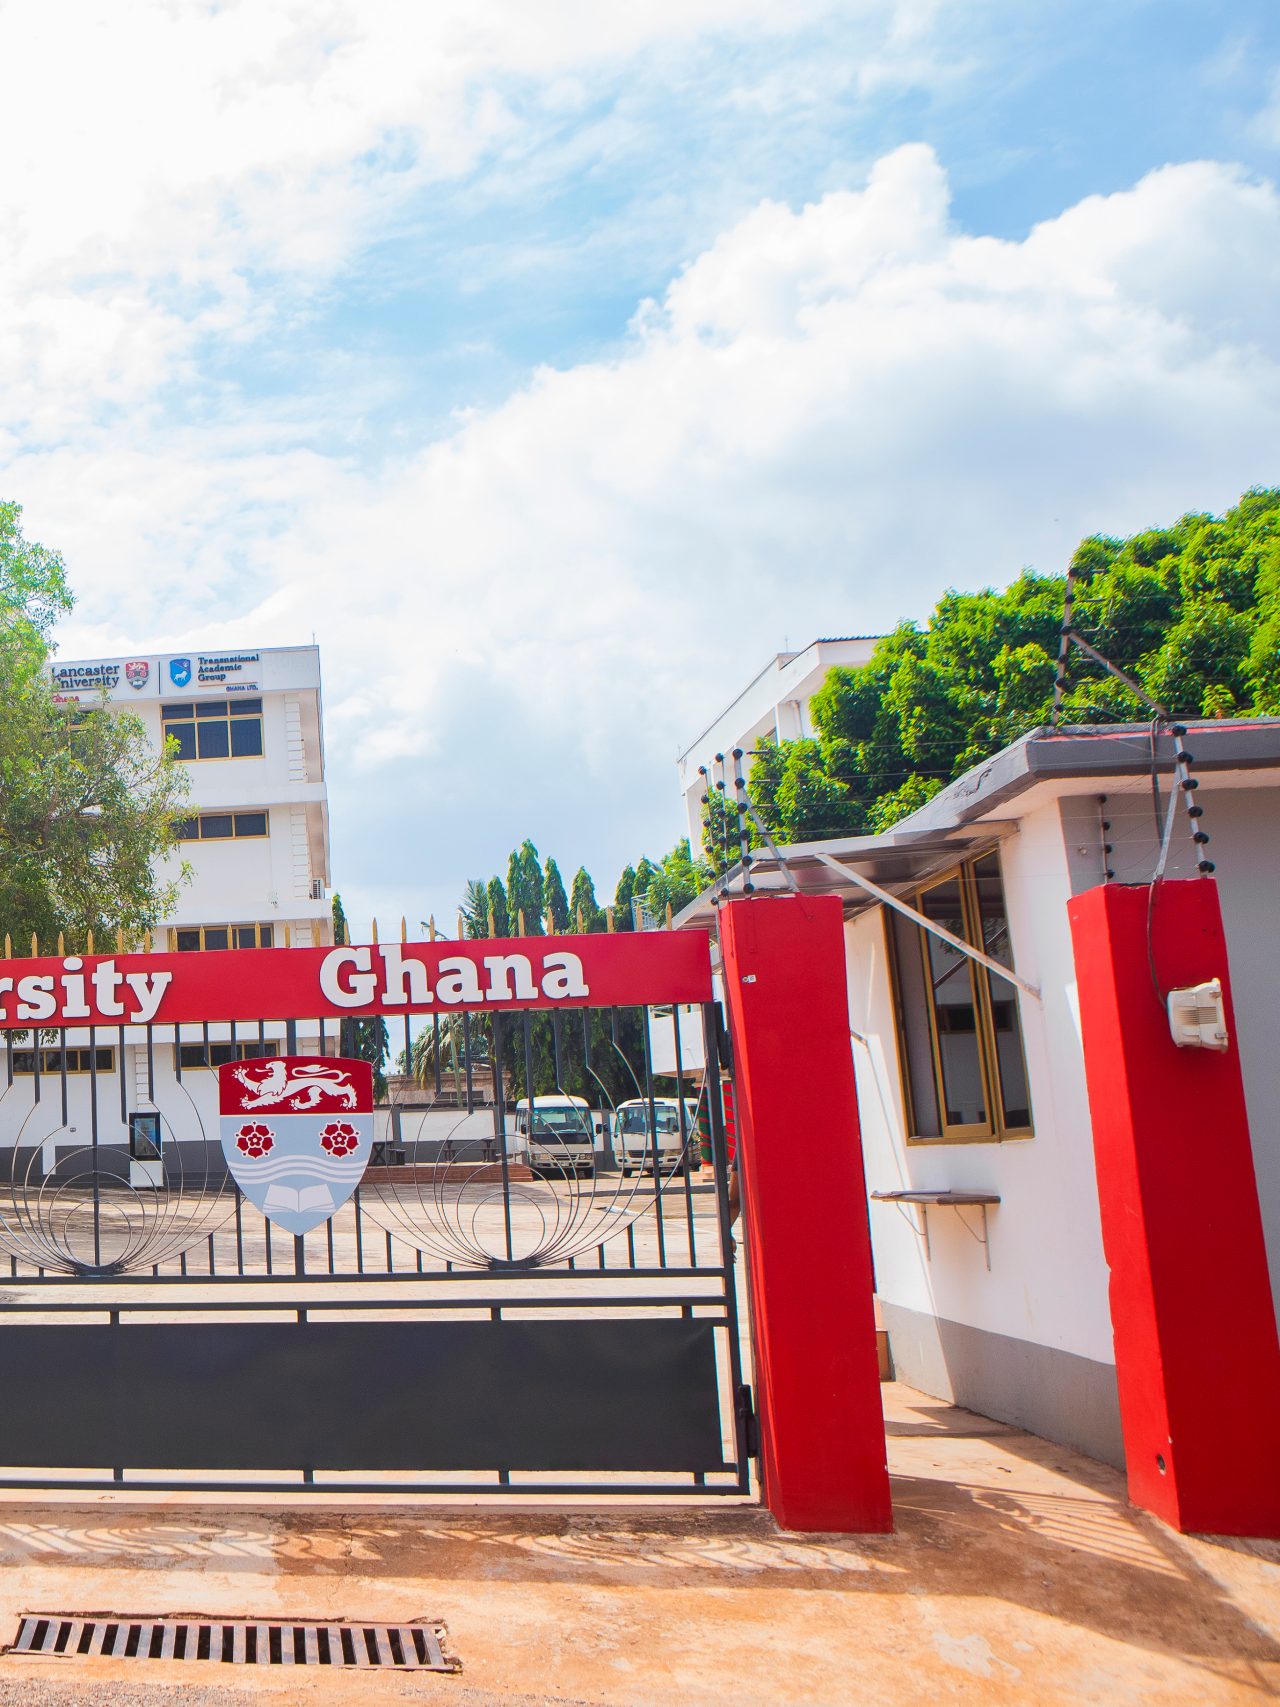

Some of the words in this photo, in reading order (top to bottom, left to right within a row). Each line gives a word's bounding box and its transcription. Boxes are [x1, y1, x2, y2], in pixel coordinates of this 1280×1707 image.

[198, 653, 259, 665] Transnational
[51, 663, 120, 678] Lancaster
[198, 663, 242, 673] Academic
[198, 673, 226, 682] Group
[320, 944, 590, 1008] Ghana
